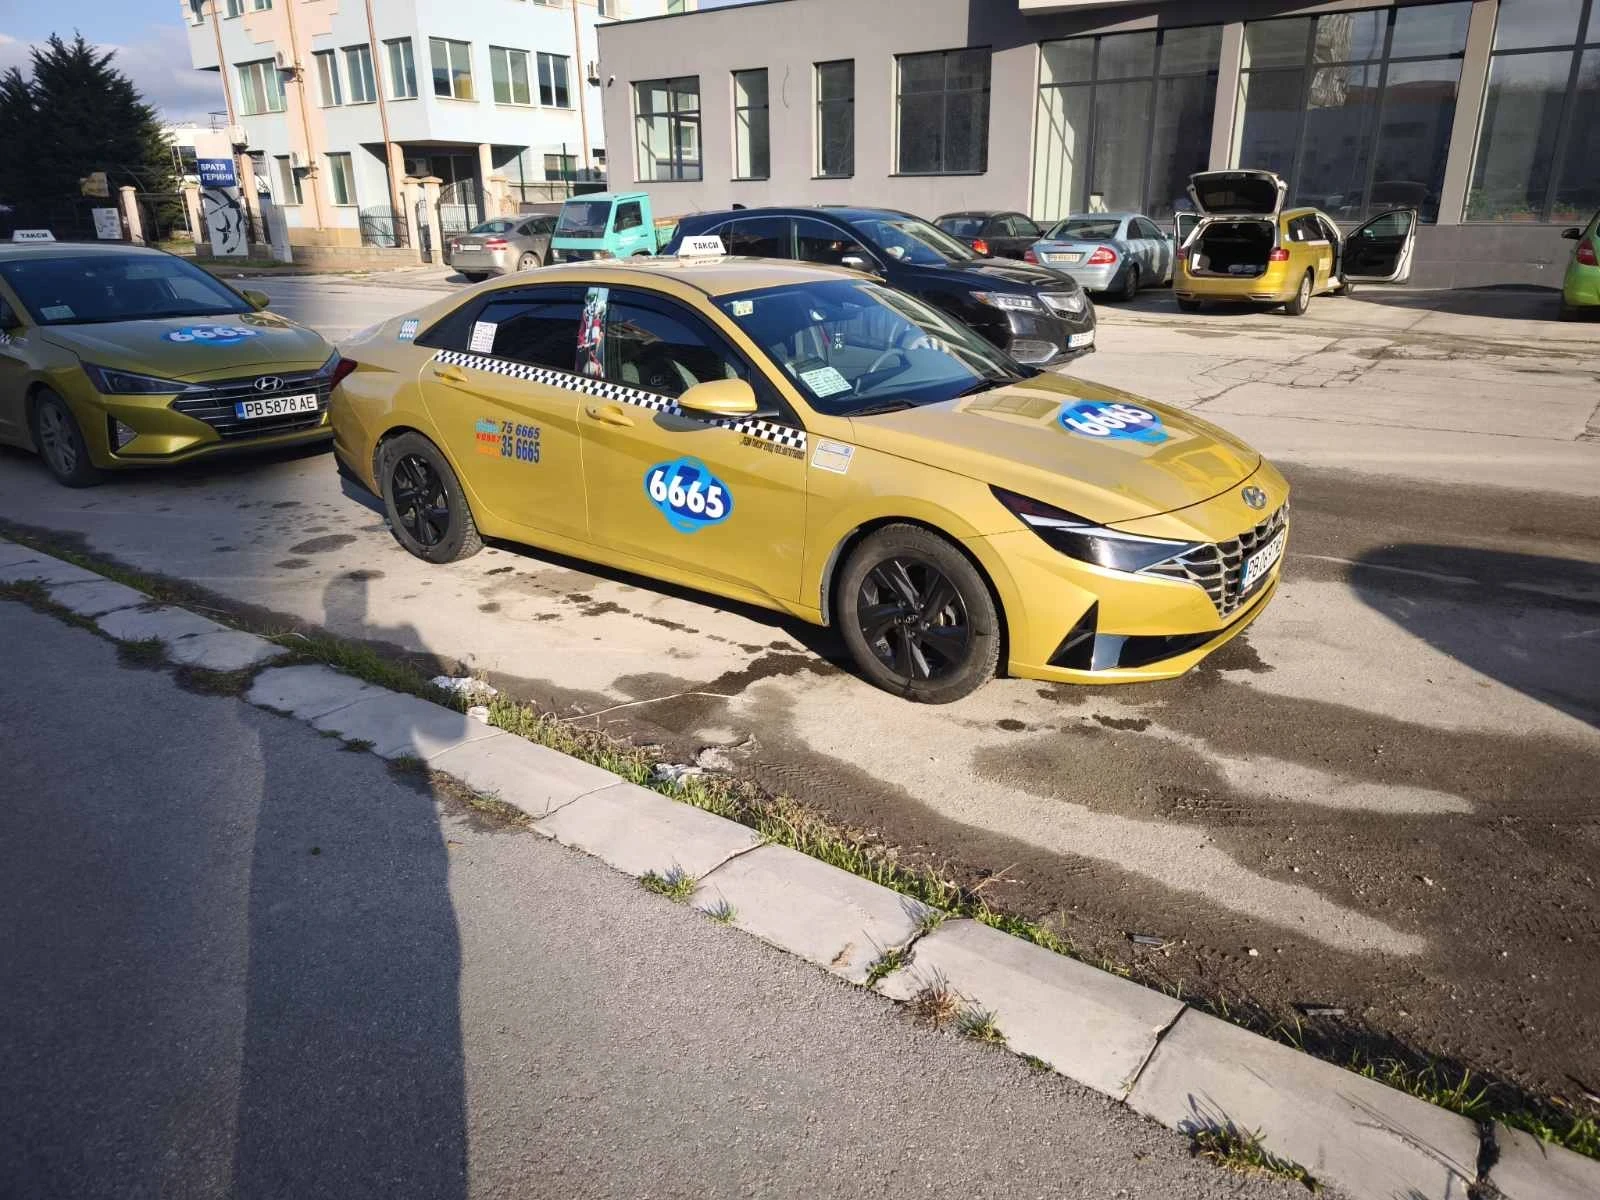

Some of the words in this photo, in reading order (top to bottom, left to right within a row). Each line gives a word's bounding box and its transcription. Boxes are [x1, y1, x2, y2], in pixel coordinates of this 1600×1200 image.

[200, 163, 226, 171] БРАТЯ
[692, 241, 719, 250] ТАКСИ
[169, 326, 257, 342] 6665
[265, 399, 297, 414] 5878
[1065, 403, 1154, 436] 6665
[501, 421, 513, 434] 75
[515, 424, 540, 439] 6665
[501, 435, 513, 457] 35
[515, 438, 540, 463] 6665
[649, 470, 724, 519] 6665
